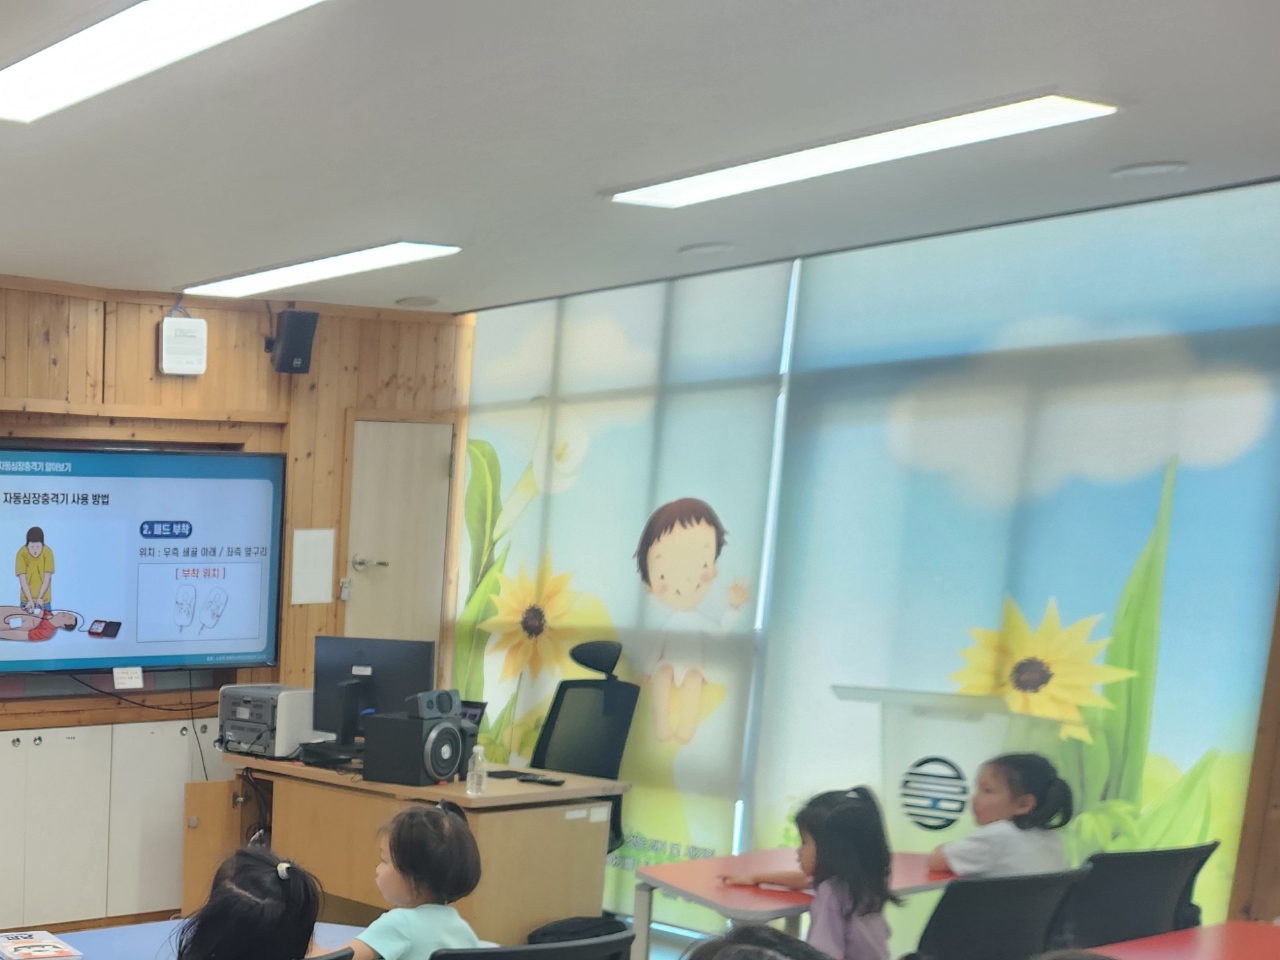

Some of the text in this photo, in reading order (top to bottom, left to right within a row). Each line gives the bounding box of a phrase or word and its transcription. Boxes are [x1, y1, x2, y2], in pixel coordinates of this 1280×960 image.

[3, 492, 110, 506] 자동심장충격기 사용 방법
[142, 523, 191, 536] 2. 패드 부착
[139, 546, 155, 558] 위치
[163, 546, 179, 558] 우측
[201, 546, 217, 558] 아래
[226, 546, 242, 558] 좌측
[245, 546, 268, 557] 옆구리
[182, 567, 200, 580] 부착
[203, 567, 220, 580] 위치
